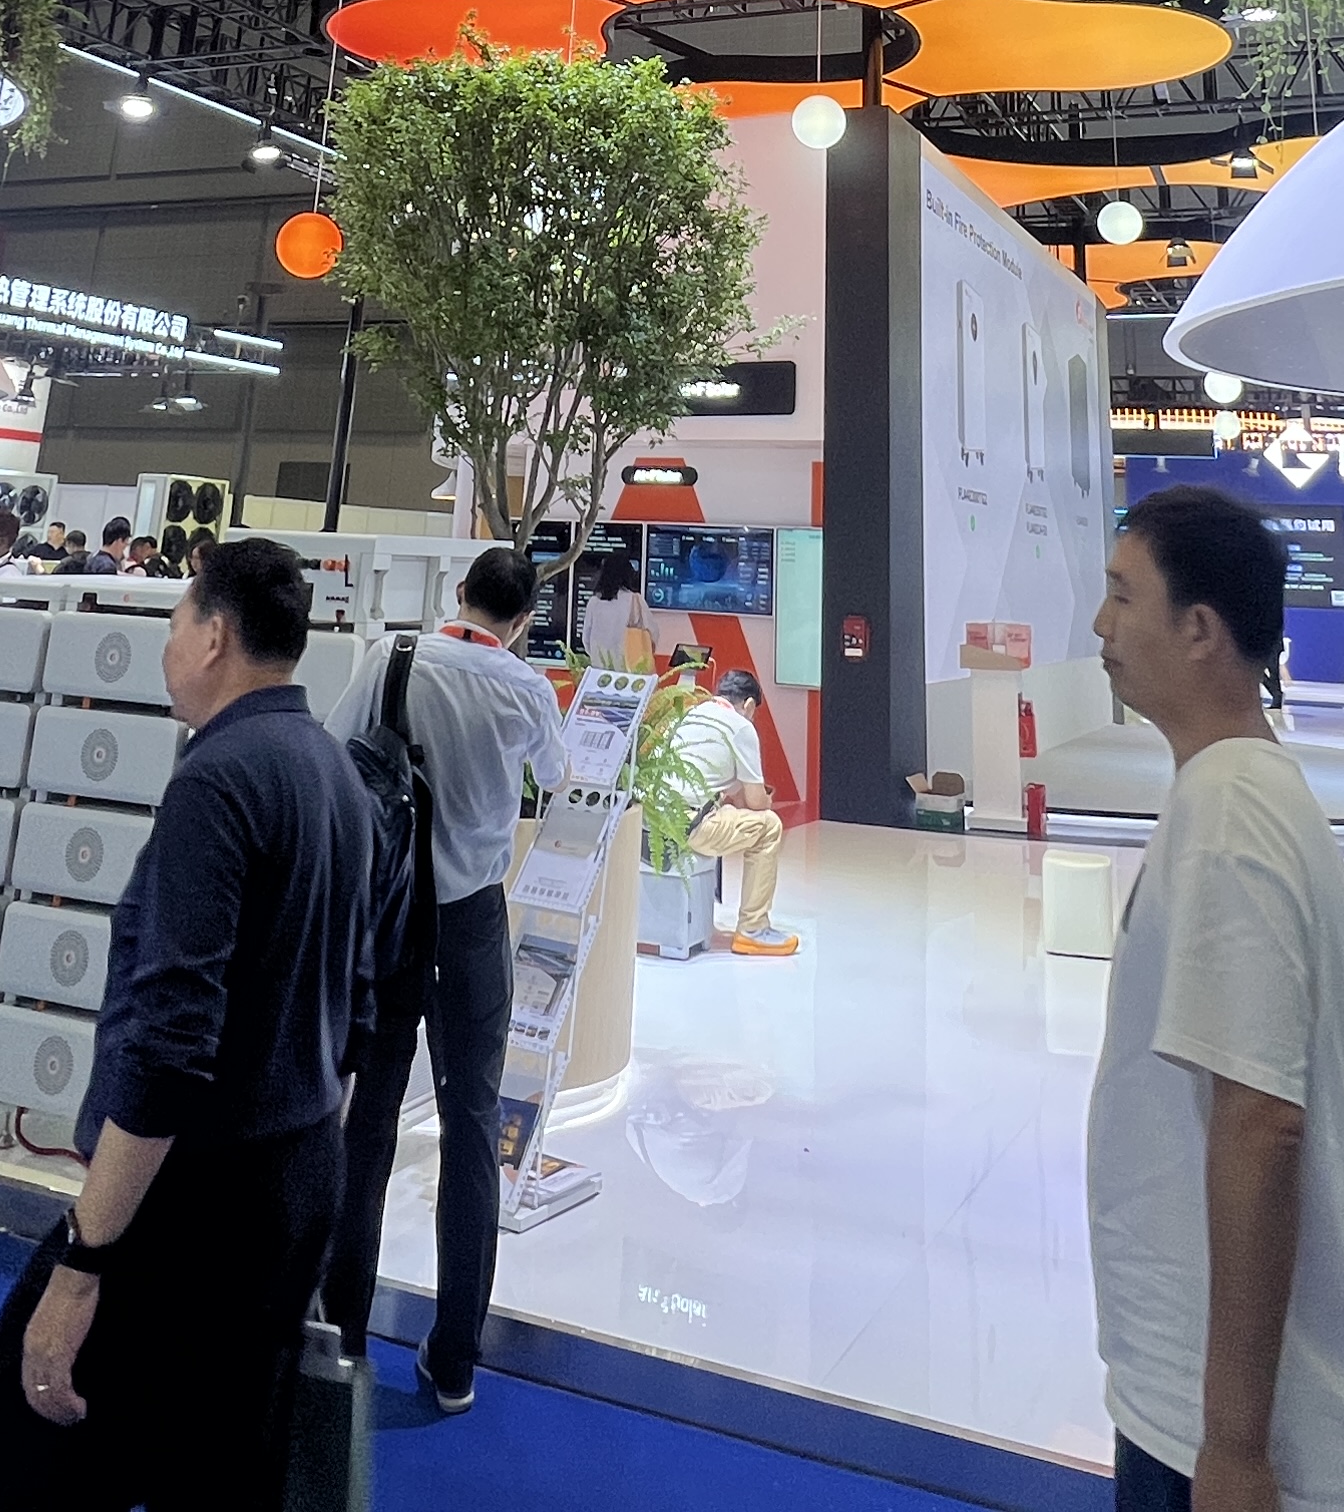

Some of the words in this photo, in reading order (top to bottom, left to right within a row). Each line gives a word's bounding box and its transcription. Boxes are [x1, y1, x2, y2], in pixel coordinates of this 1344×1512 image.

[926, 188, 953, 228] Built-in
[954, 211, 968, 239] Fire
[969, 224, 1001, 264] Protection
